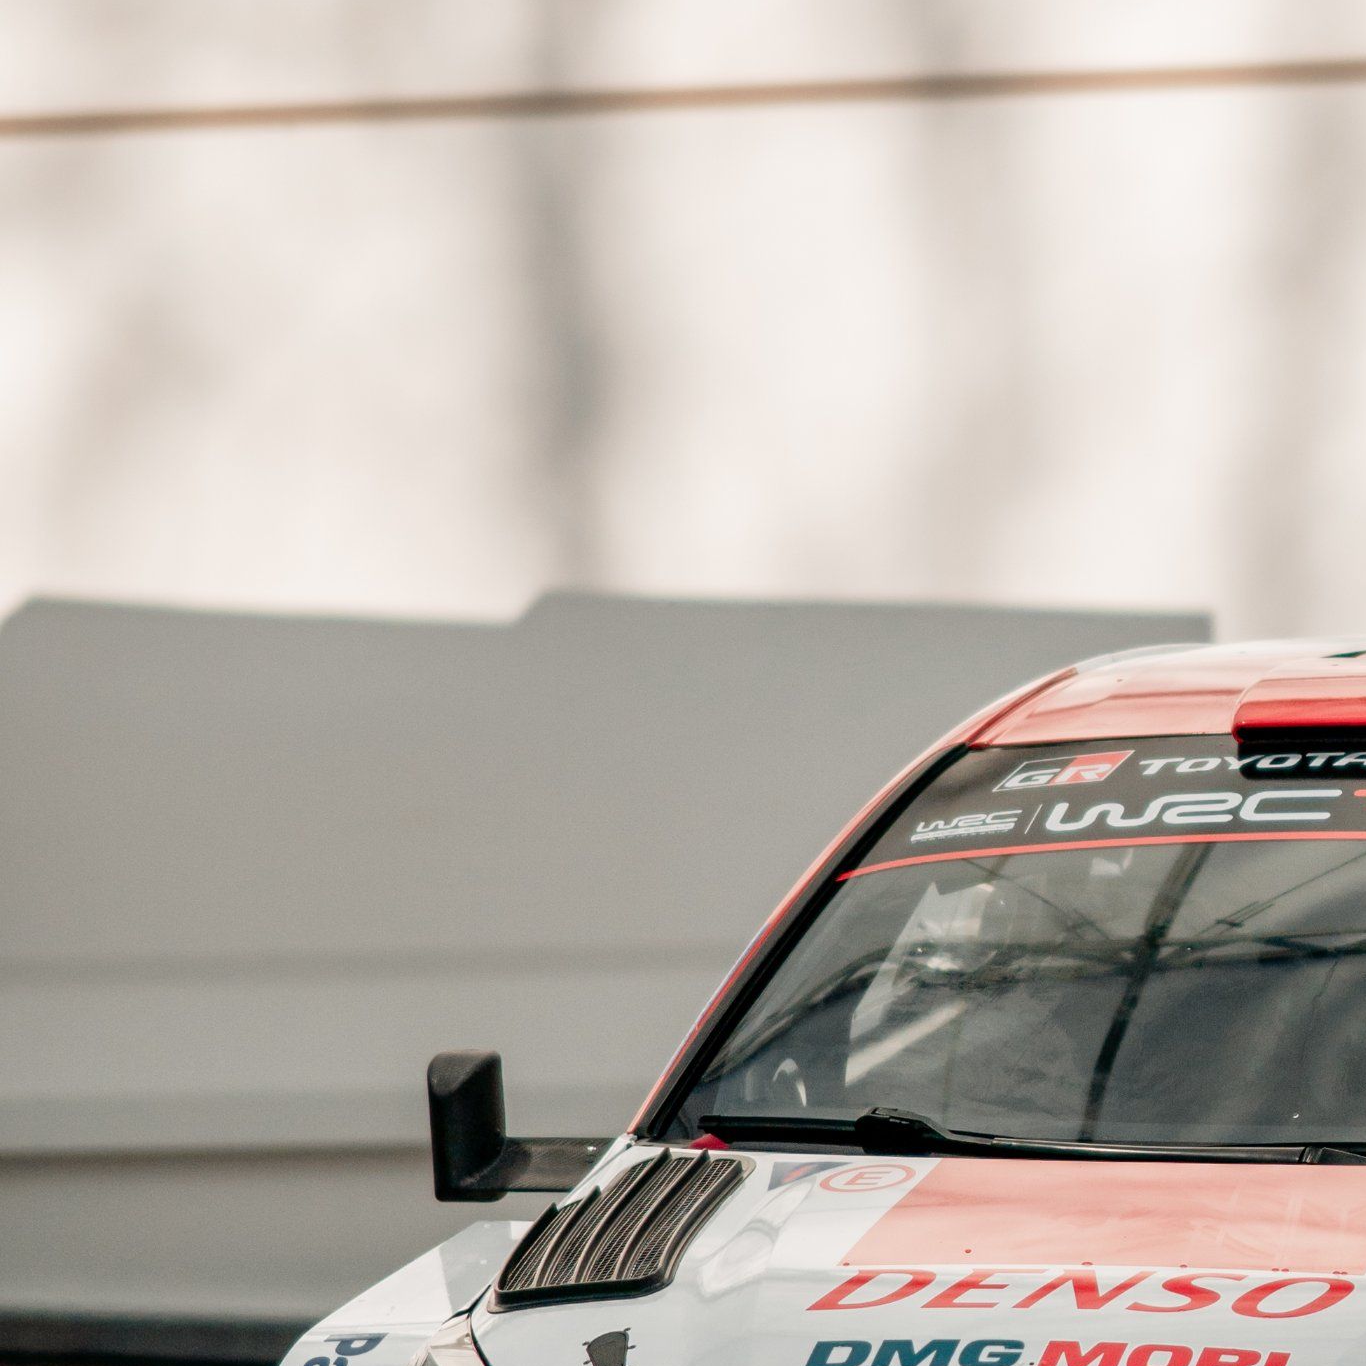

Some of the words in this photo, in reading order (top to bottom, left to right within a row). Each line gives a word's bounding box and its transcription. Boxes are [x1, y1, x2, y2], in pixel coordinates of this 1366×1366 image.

[1004, 762, 1112, 788] GR
[915, 809, 1022, 833] WRC
[805, 1267, 1356, 1319] DENSO
